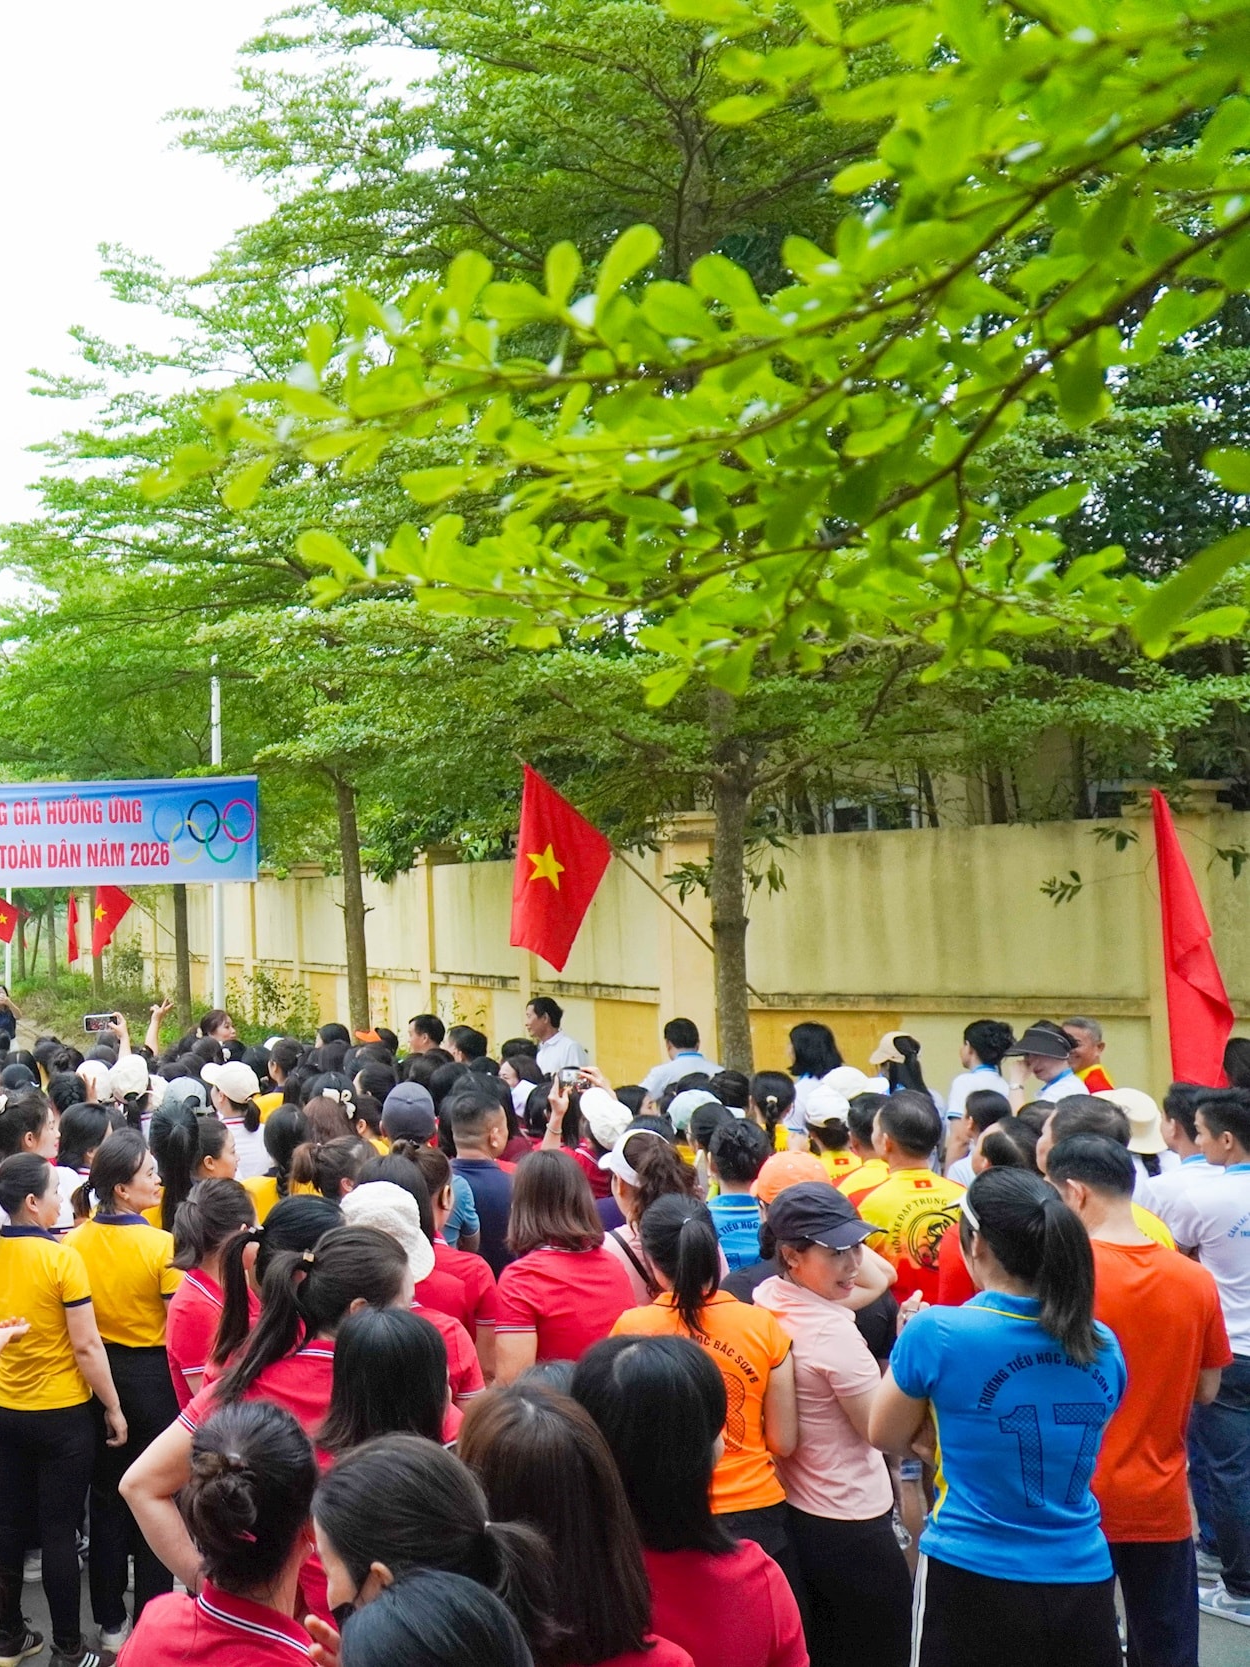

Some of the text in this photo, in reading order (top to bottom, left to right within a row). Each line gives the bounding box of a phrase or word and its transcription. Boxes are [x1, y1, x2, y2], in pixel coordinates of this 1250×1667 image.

[13, 797, 41, 826] GIÃ
[46, 793, 102, 825] HƯỞNG
[108, 794, 142, 824] ỨNG
[47, 838, 82, 869] DÂN
[87, 838, 125, 867] NĂM
[131, 842, 170, 867] 2026
[998, 1402, 1106, 1508] 17
